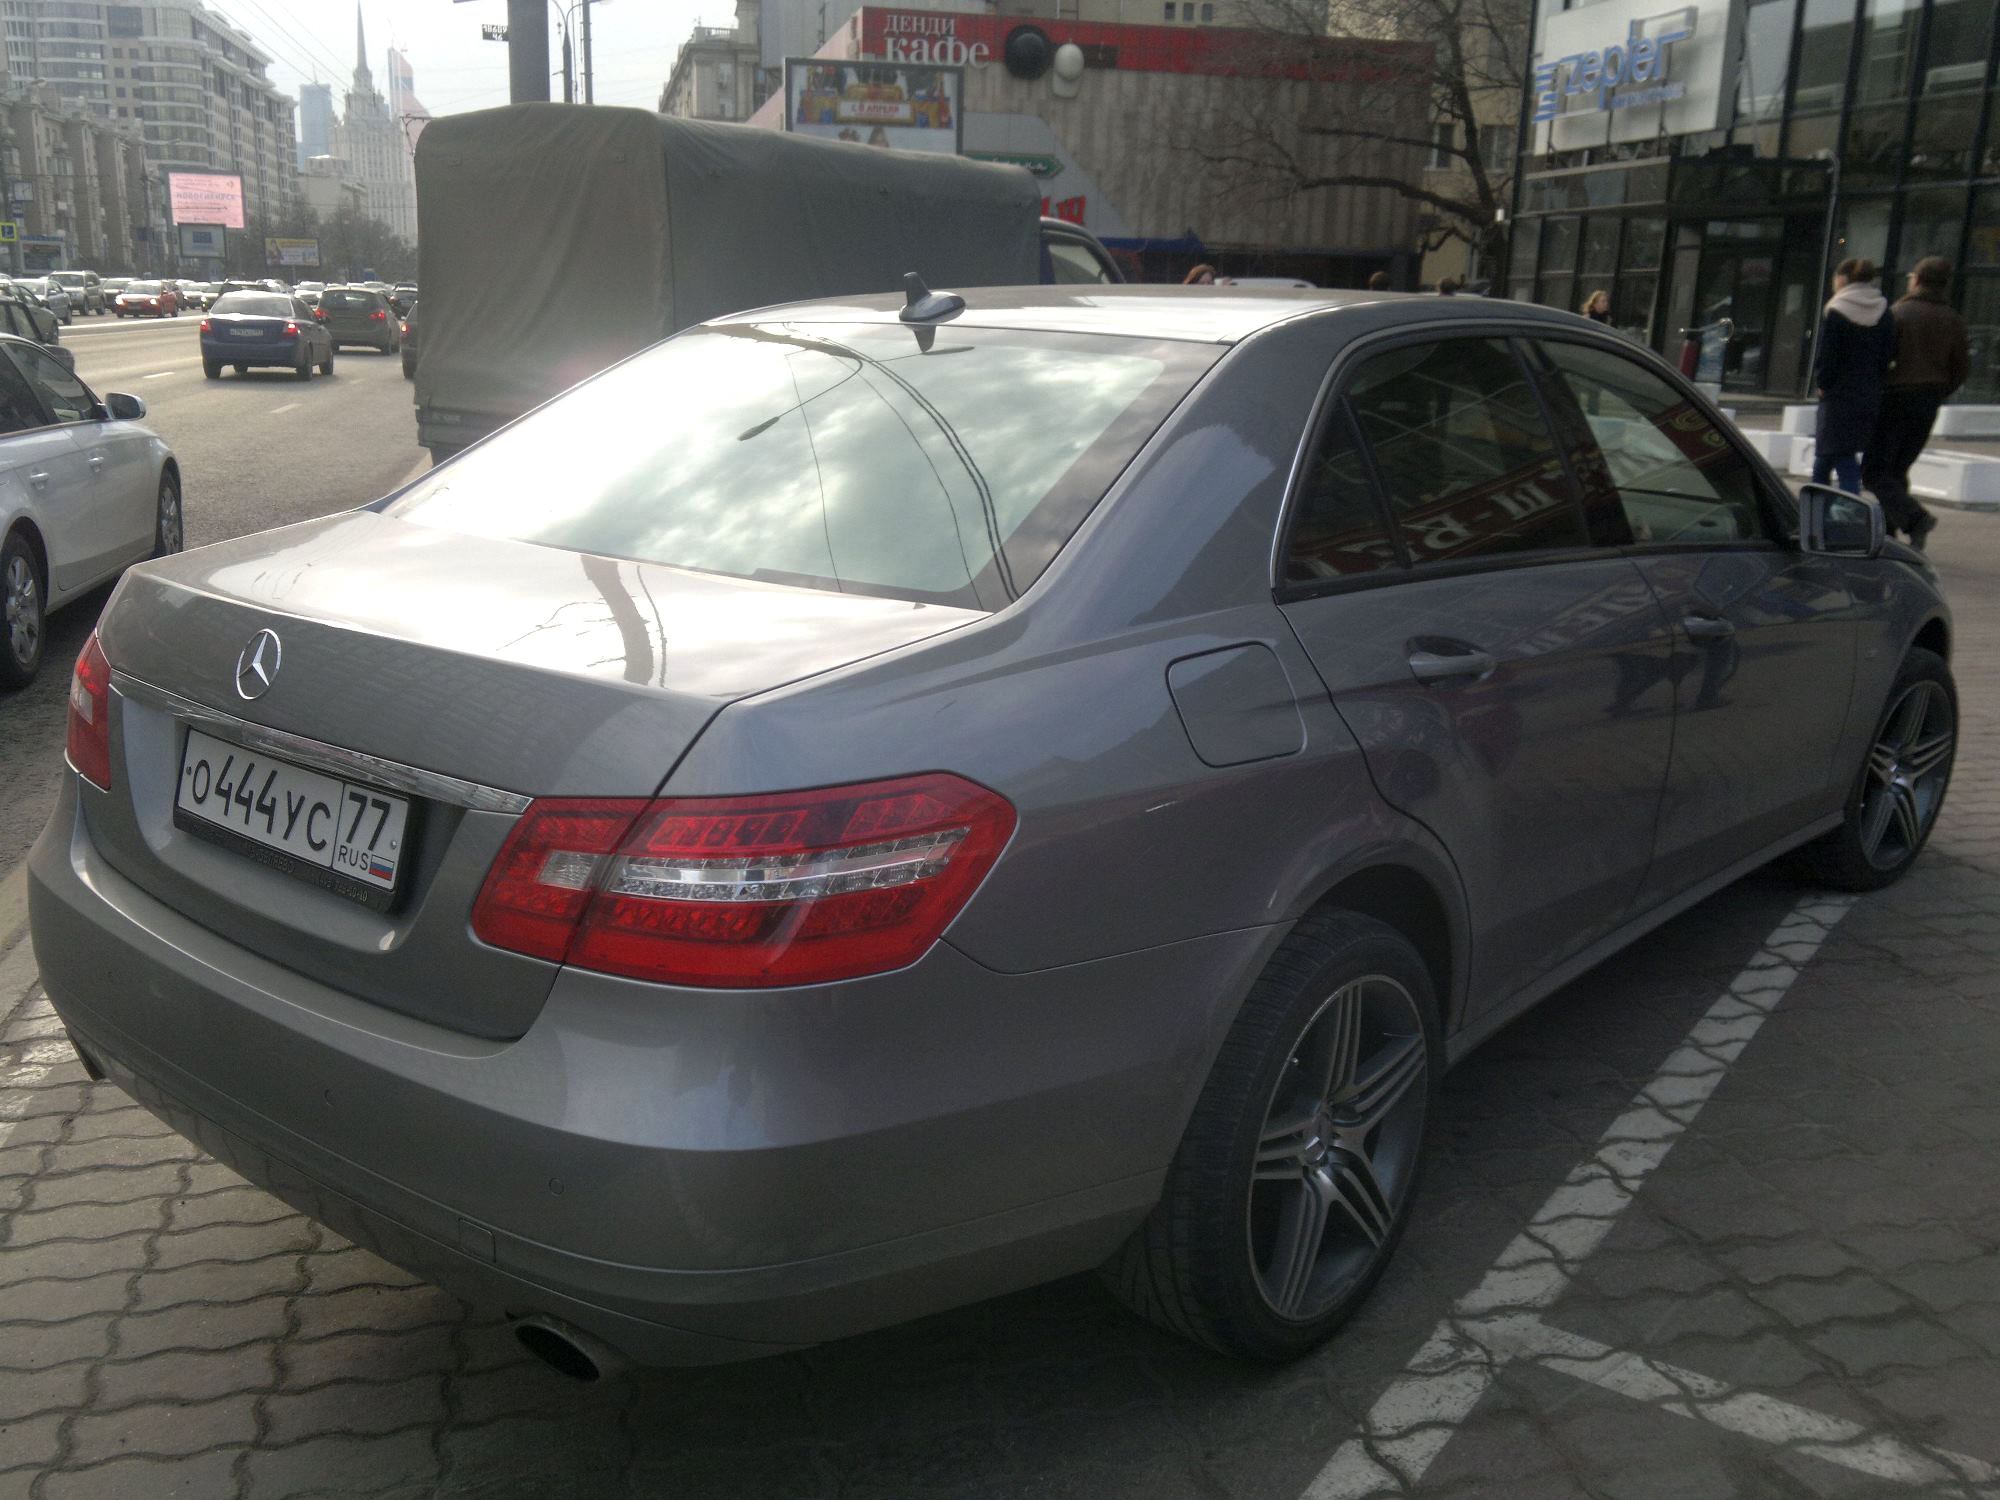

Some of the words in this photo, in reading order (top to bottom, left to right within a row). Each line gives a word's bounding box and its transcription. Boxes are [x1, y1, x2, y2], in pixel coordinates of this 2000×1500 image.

[883, 14, 955, 36] ДЕНДИ
[346, 791, 391, 851] 77
[337, 844, 370, 872] RUS
